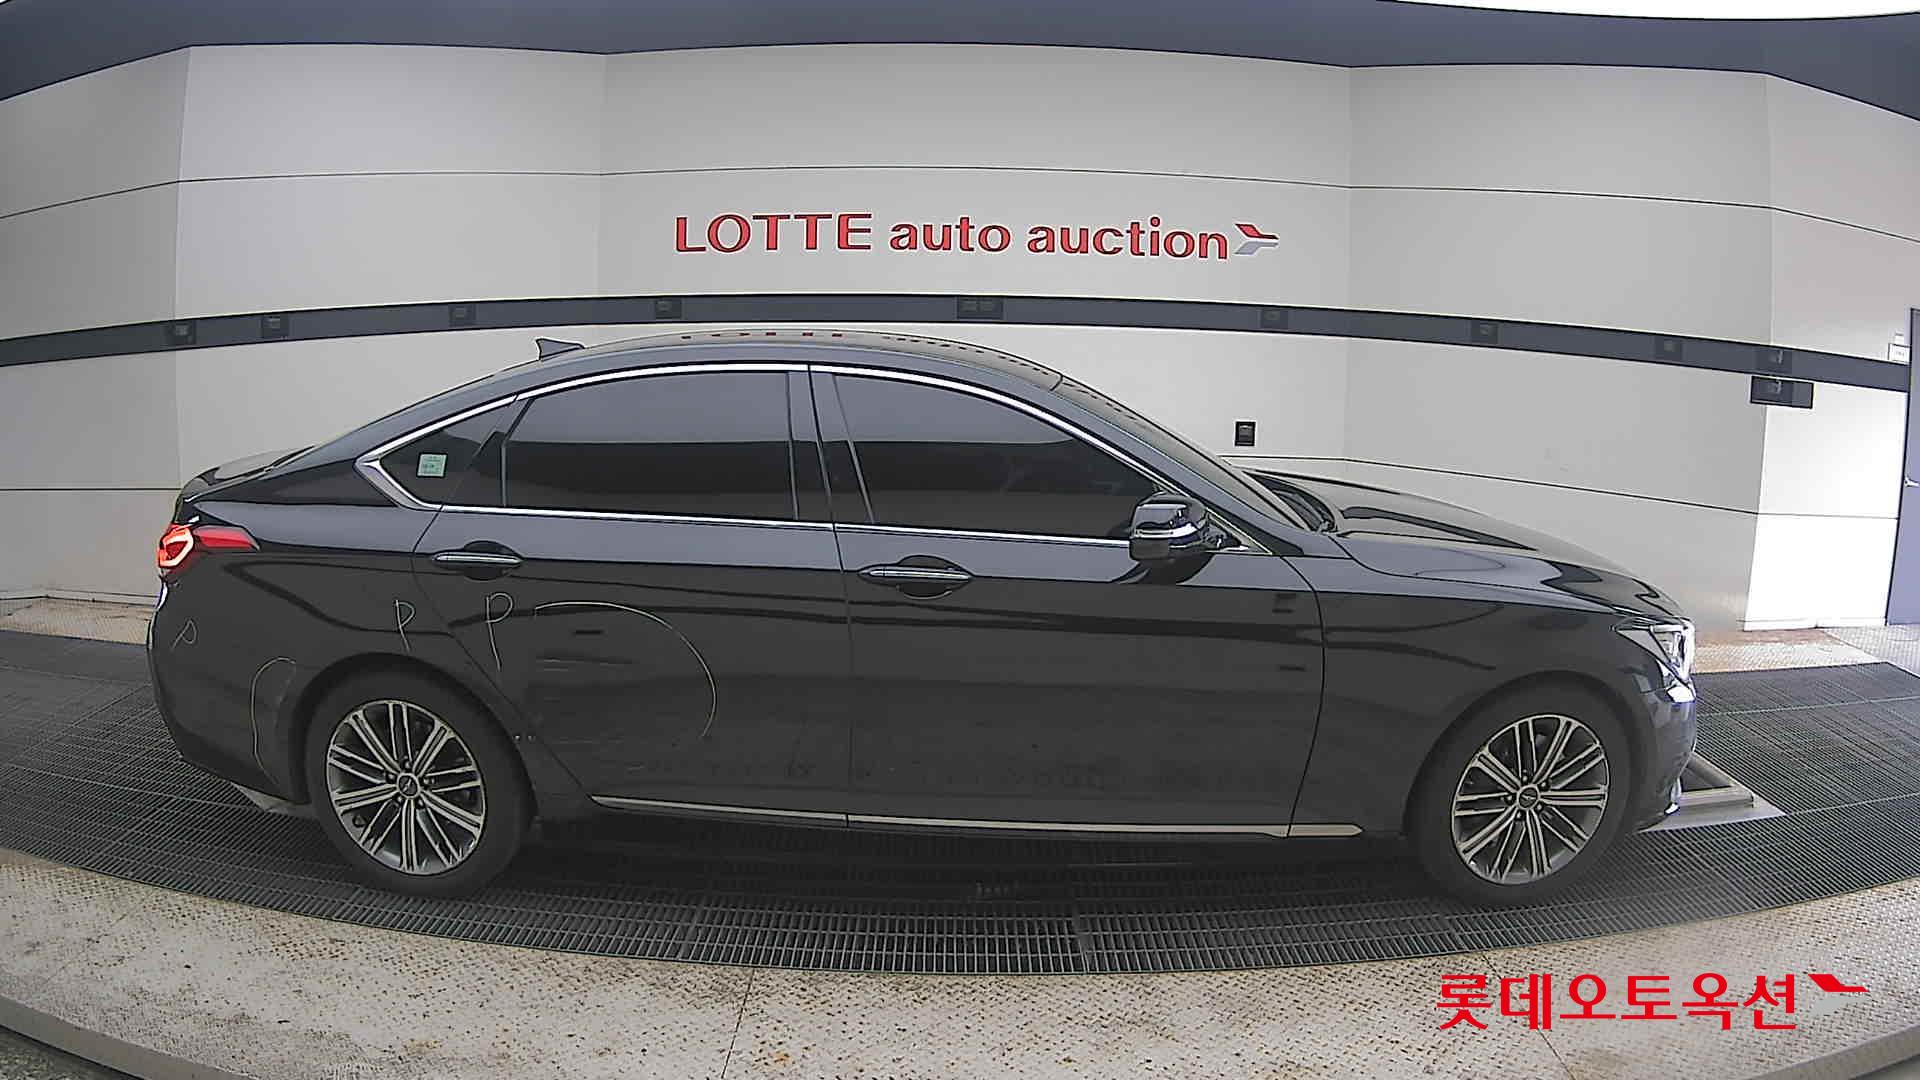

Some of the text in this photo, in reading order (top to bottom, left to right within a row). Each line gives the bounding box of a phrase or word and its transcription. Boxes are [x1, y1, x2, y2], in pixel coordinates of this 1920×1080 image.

[675, 213, 1228, 260] LOTTE auto auction
